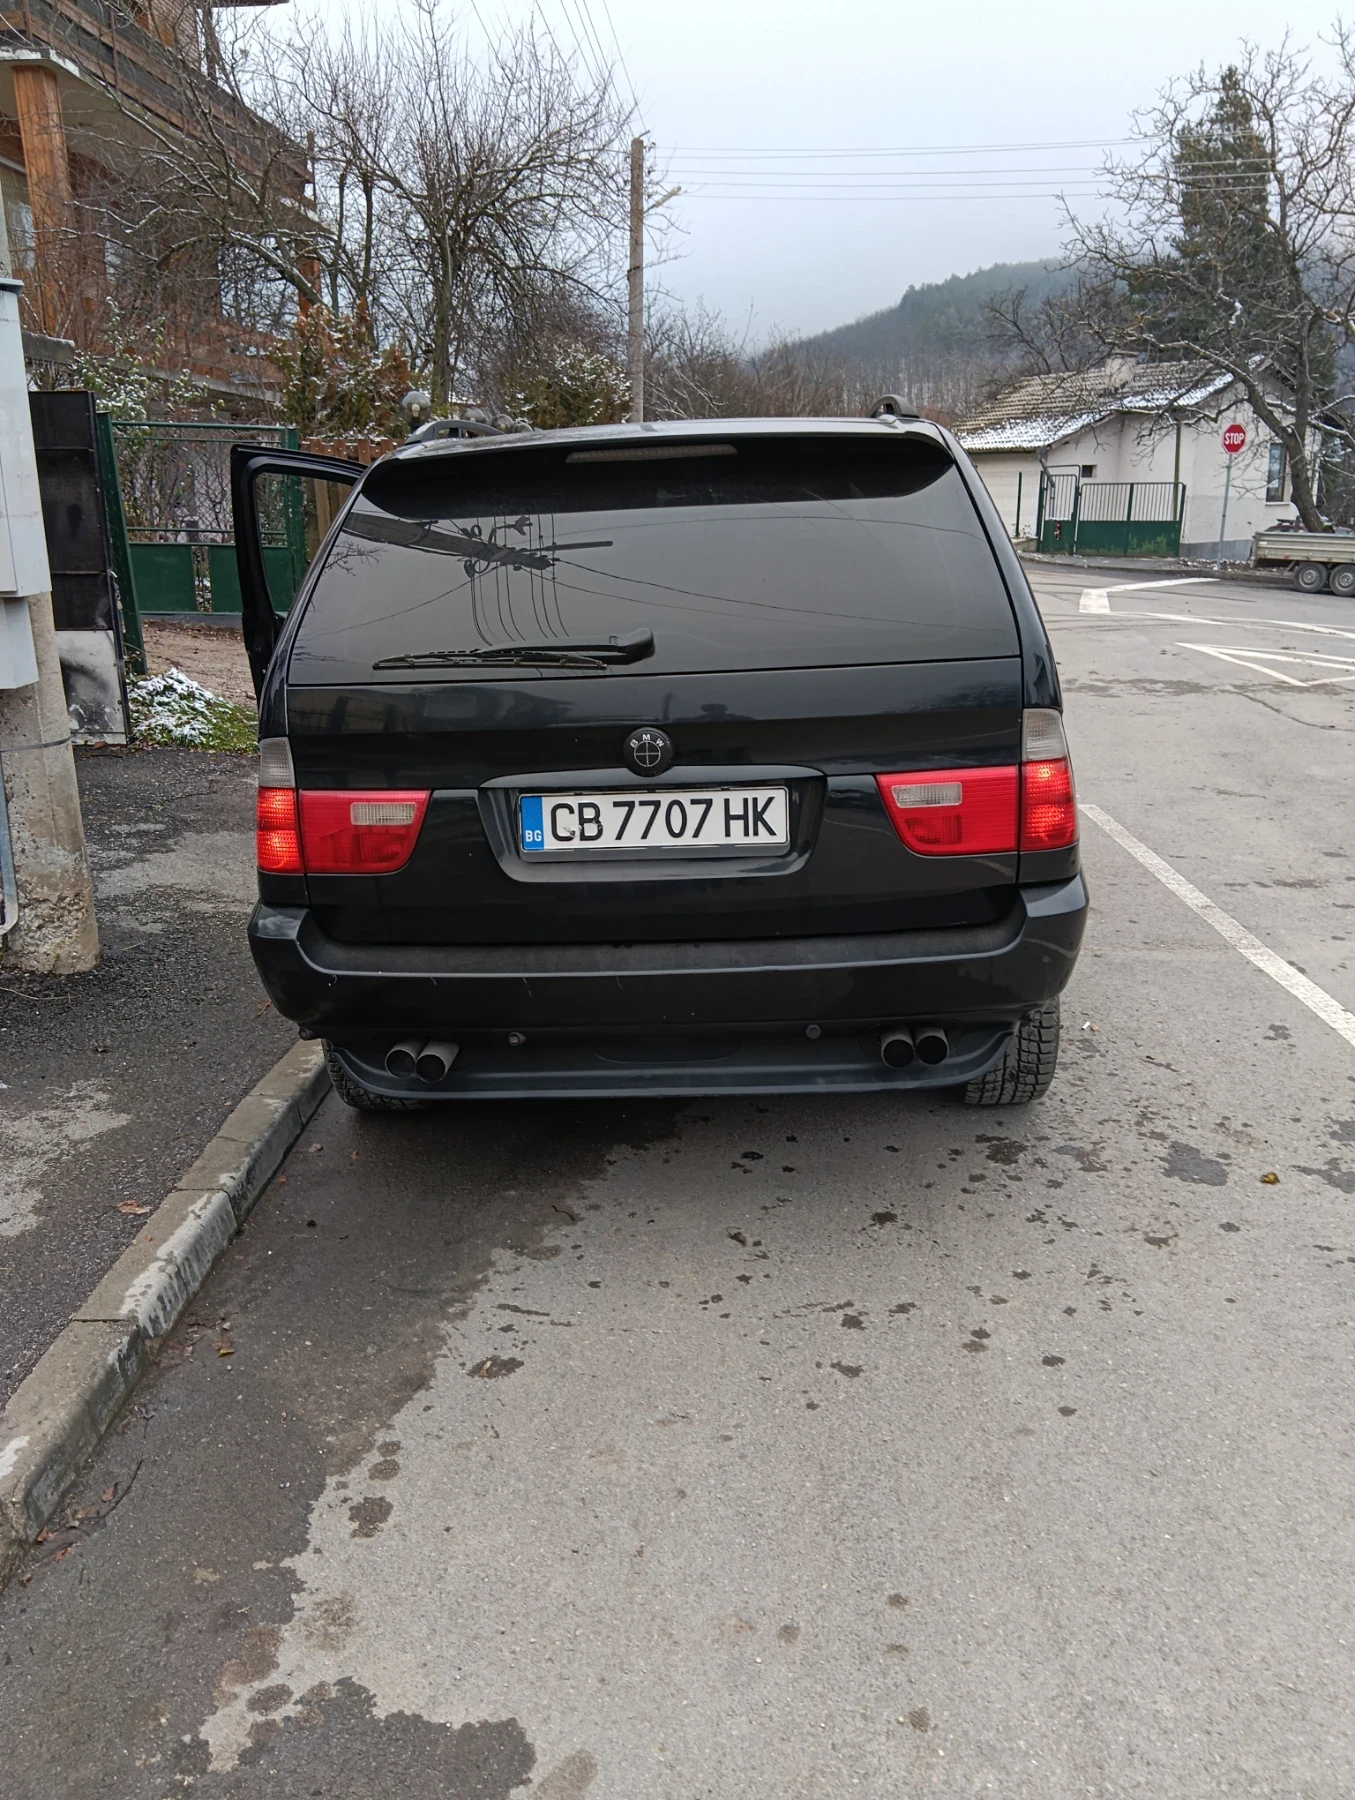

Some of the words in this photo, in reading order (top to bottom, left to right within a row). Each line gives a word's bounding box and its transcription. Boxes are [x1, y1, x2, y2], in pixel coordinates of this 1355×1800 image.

[1224, 432, 1245, 445] STOP
[630, 733, 665, 748] BMW
[550, 802, 603, 842] CB
[612, 798, 714, 840] 7707
[723, 796, 777, 838] HK
[525, 829, 542, 842] BG
